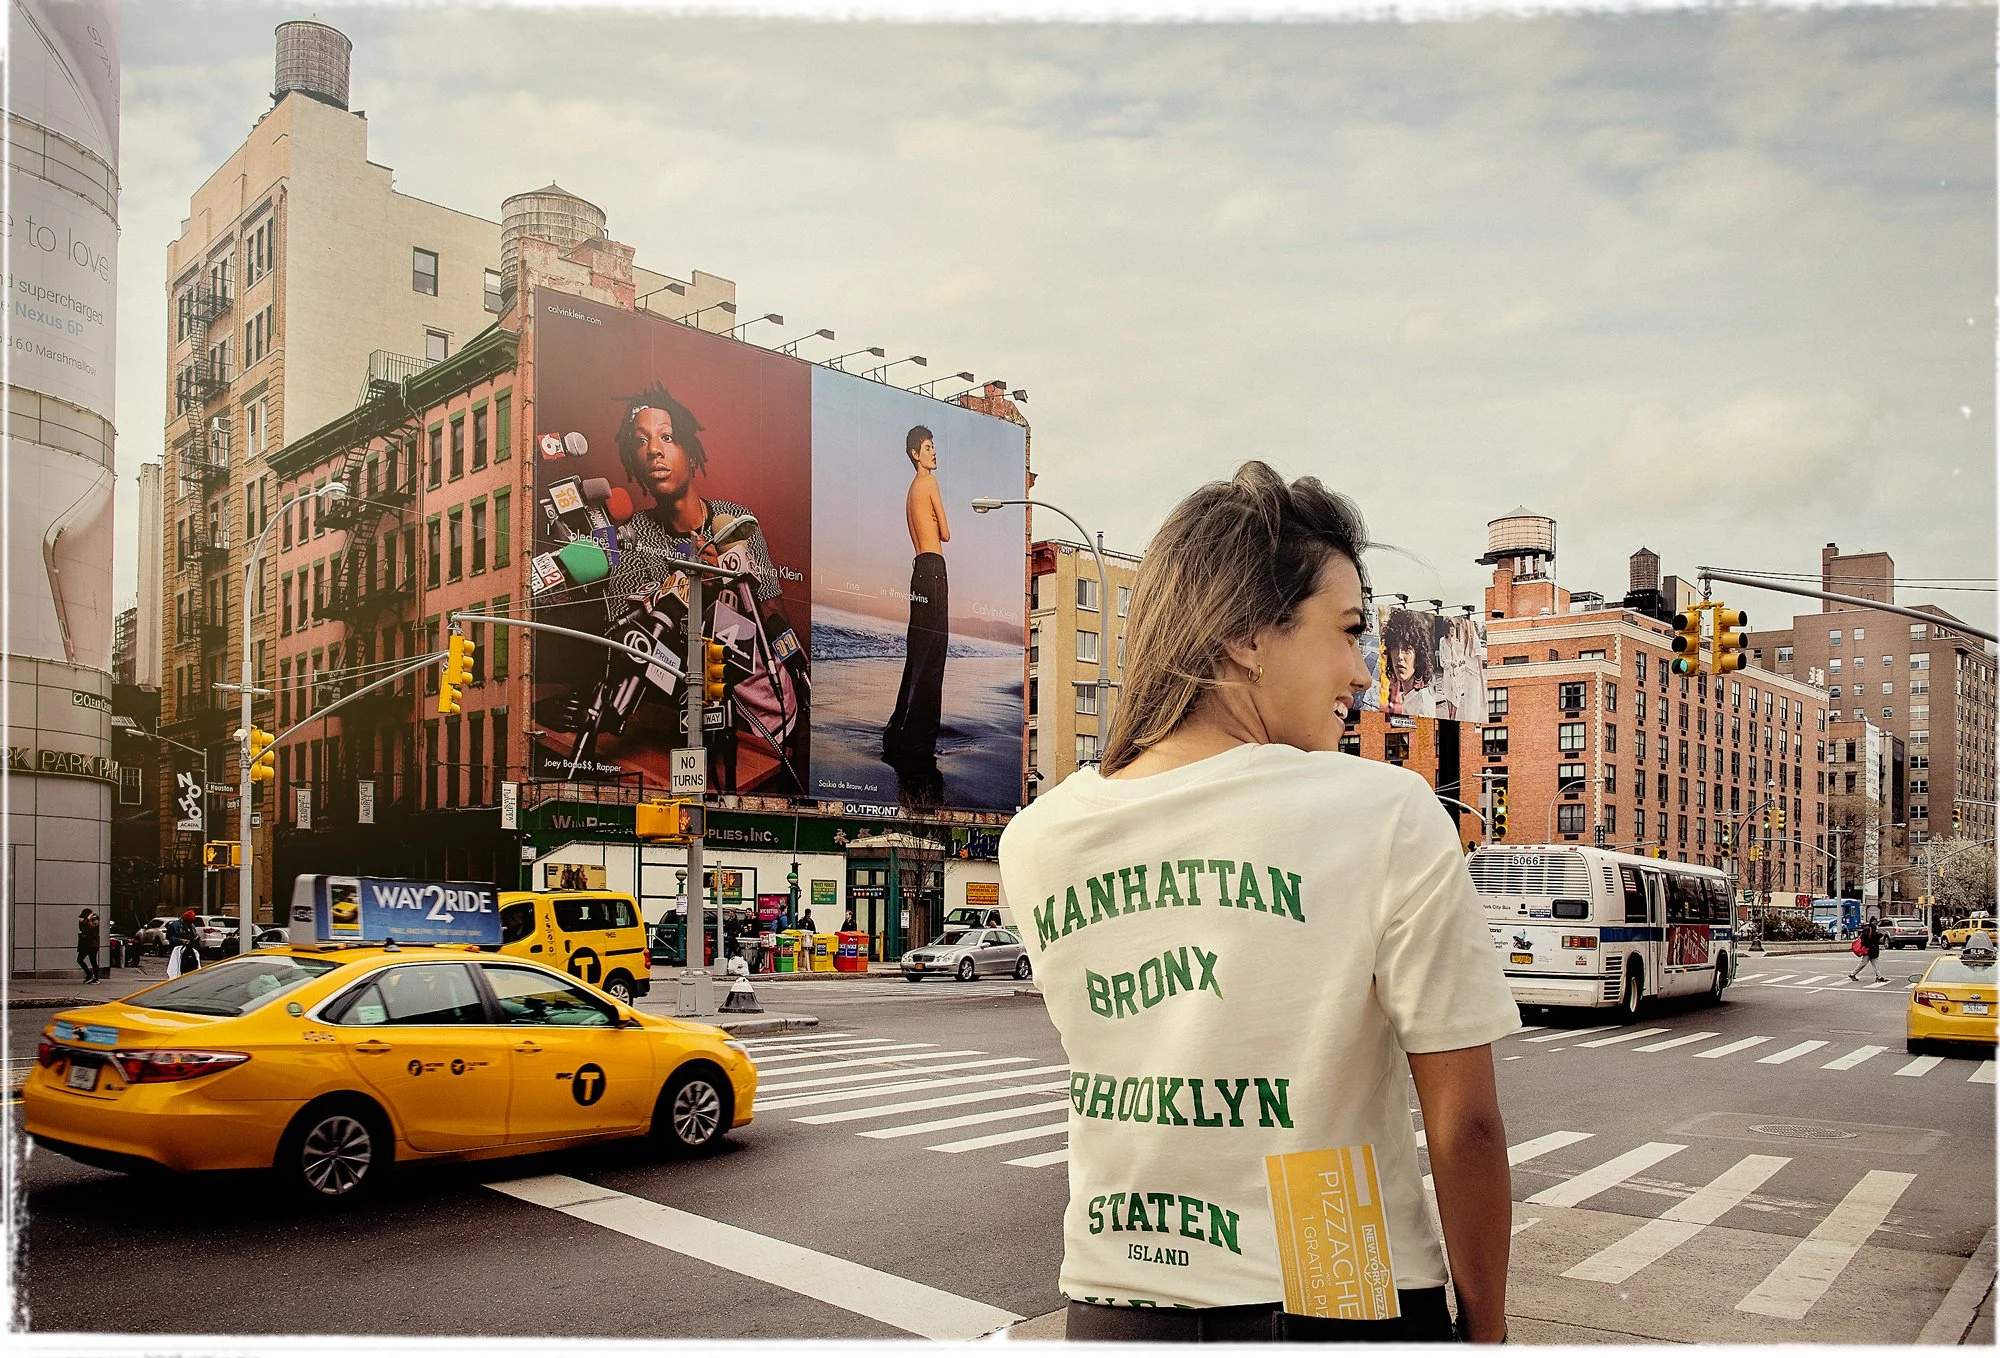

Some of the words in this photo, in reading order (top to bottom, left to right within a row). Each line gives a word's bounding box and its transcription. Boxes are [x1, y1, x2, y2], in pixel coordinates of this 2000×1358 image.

[25, 216, 56, 252] to
[68, 227, 111, 284] love.
[19, 280, 104, 327] supercharged.
[548, 305, 602, 325] calvinklein.com
[15, 301, 63, 329] Nexus
[67, 319, 84, 336] 6P
[16, 338, 33, 352] 6.0
[36, 344, 97, 376] Marshmallow
[555, 489, 570, 508] 18
[570, 529, 605, 547] pledge
[624, 539, 633, 550] in
[747, 560, 778, 577] Calvin
[779, 565, 803, 582] Klein
[846, 581, 860, 592] rise
[880, 585, 887, 595] in
[889, 586, 929, 604] #mycalvins
[972, 601, 999, 617] Calvin
[999, 606, 1017, 621] Klein
[706, 714, 720, 723] WAY
[42, 751, 94, 774] PARK
[544, 758, 561, 769] Joey
[596, 762, 622, 774] Rapper
[681, 757, 696, 769] NO
[673, 774, 704, 786] TURNS
[818, 779, 837, 789] Saskia
[864, 784, 878, 792] Artist
[846, 803, 898, 816] OUTFRONT
[1513, 856, 1539, 865] 5066
[372, 885, 492, 923] WAY2RIDE
[1033, 859, 1306, 952] MANHATTAN
[1085, 946, 1223, 1018] BRONX
[580, 1072, 600, 1100] T
[1070, 1072, 1294, 1128] BROOKLYN
[1088, 1192, 1242, 1255] STATEN
[1318, 1171, 1361, 1320] PIZZACHE
[1365, 1227, 1377, 1254] NEW
[1128, 1243, 1189, 1267] ISLAND
[1304, 1227, 1325, 1289] GRATIS
[1368, 1254, 1381, 1287] YORK
[1374, 1287, 1388, 1320] PIZZA
